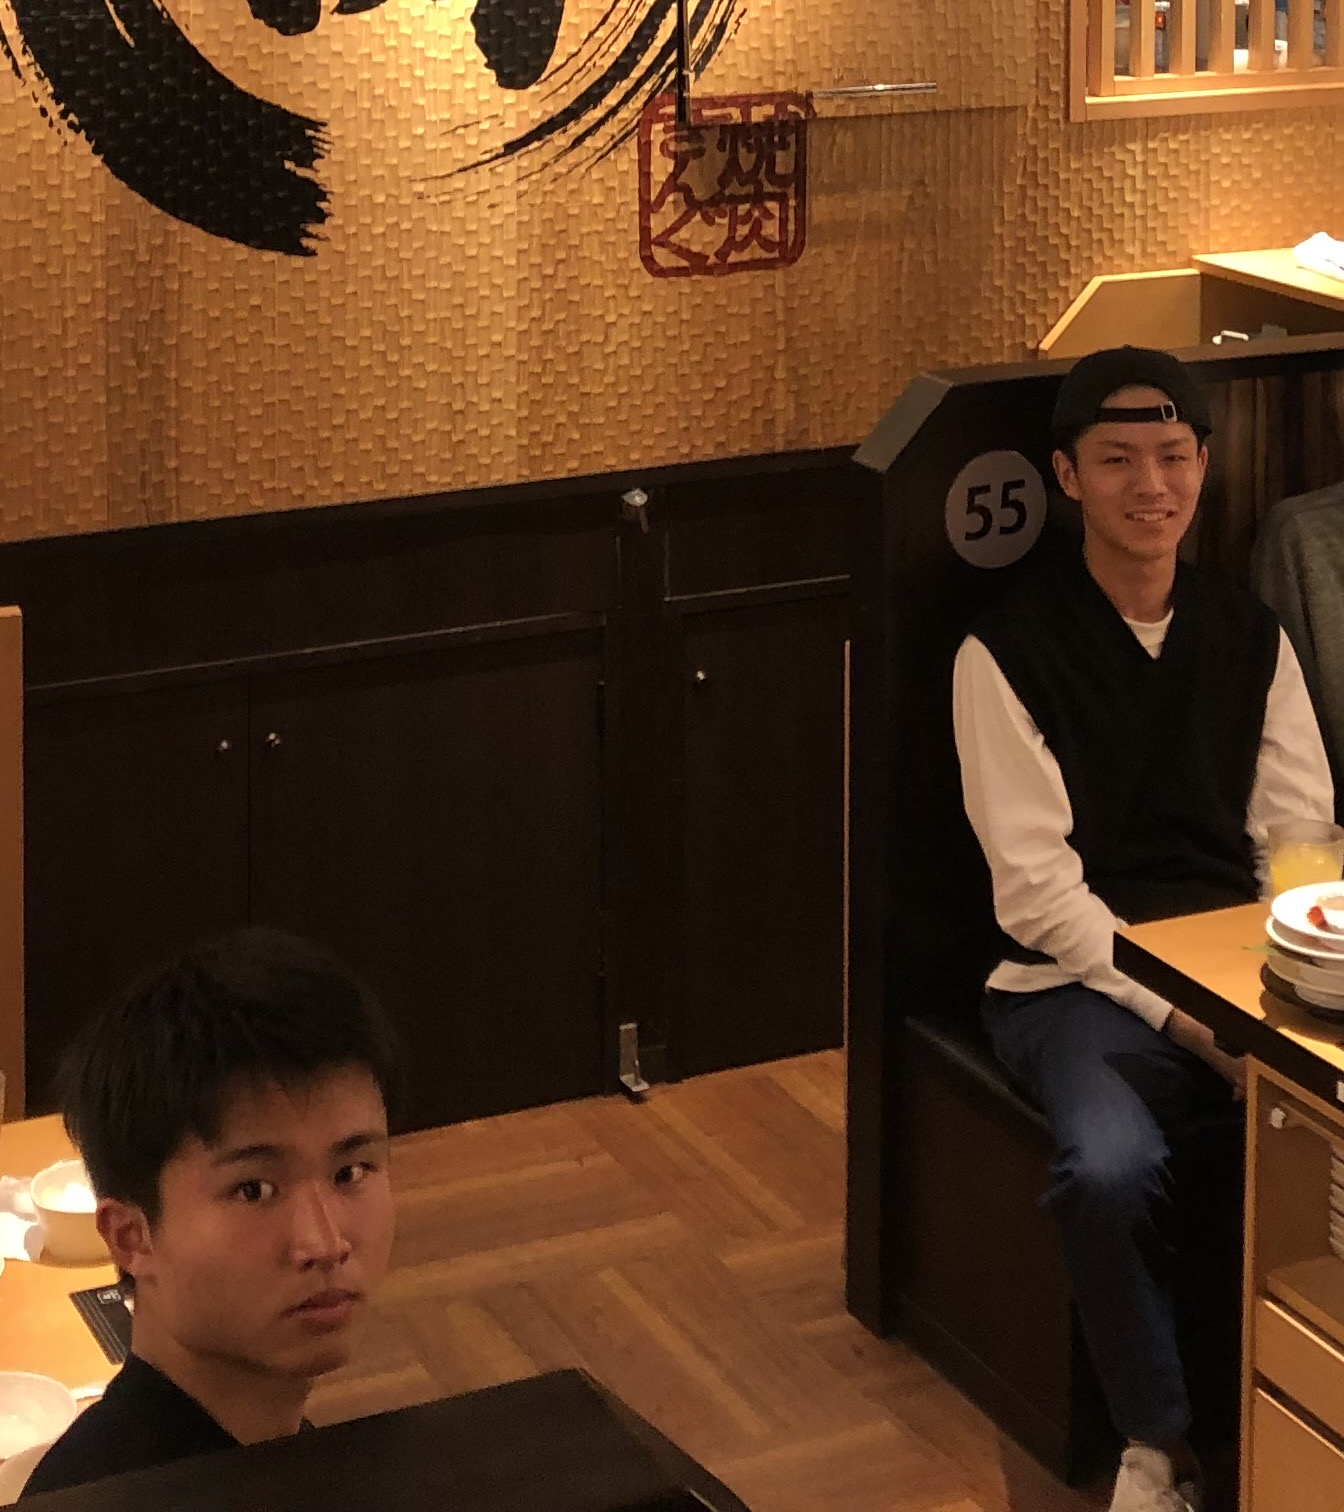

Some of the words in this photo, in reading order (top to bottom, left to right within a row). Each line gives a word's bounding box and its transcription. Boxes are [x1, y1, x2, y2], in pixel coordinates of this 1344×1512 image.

[650, 105, 728, 265] きんぐ
[714, 102, 795, 264] 焼肉
[964, 479, 1027, 541] 55
